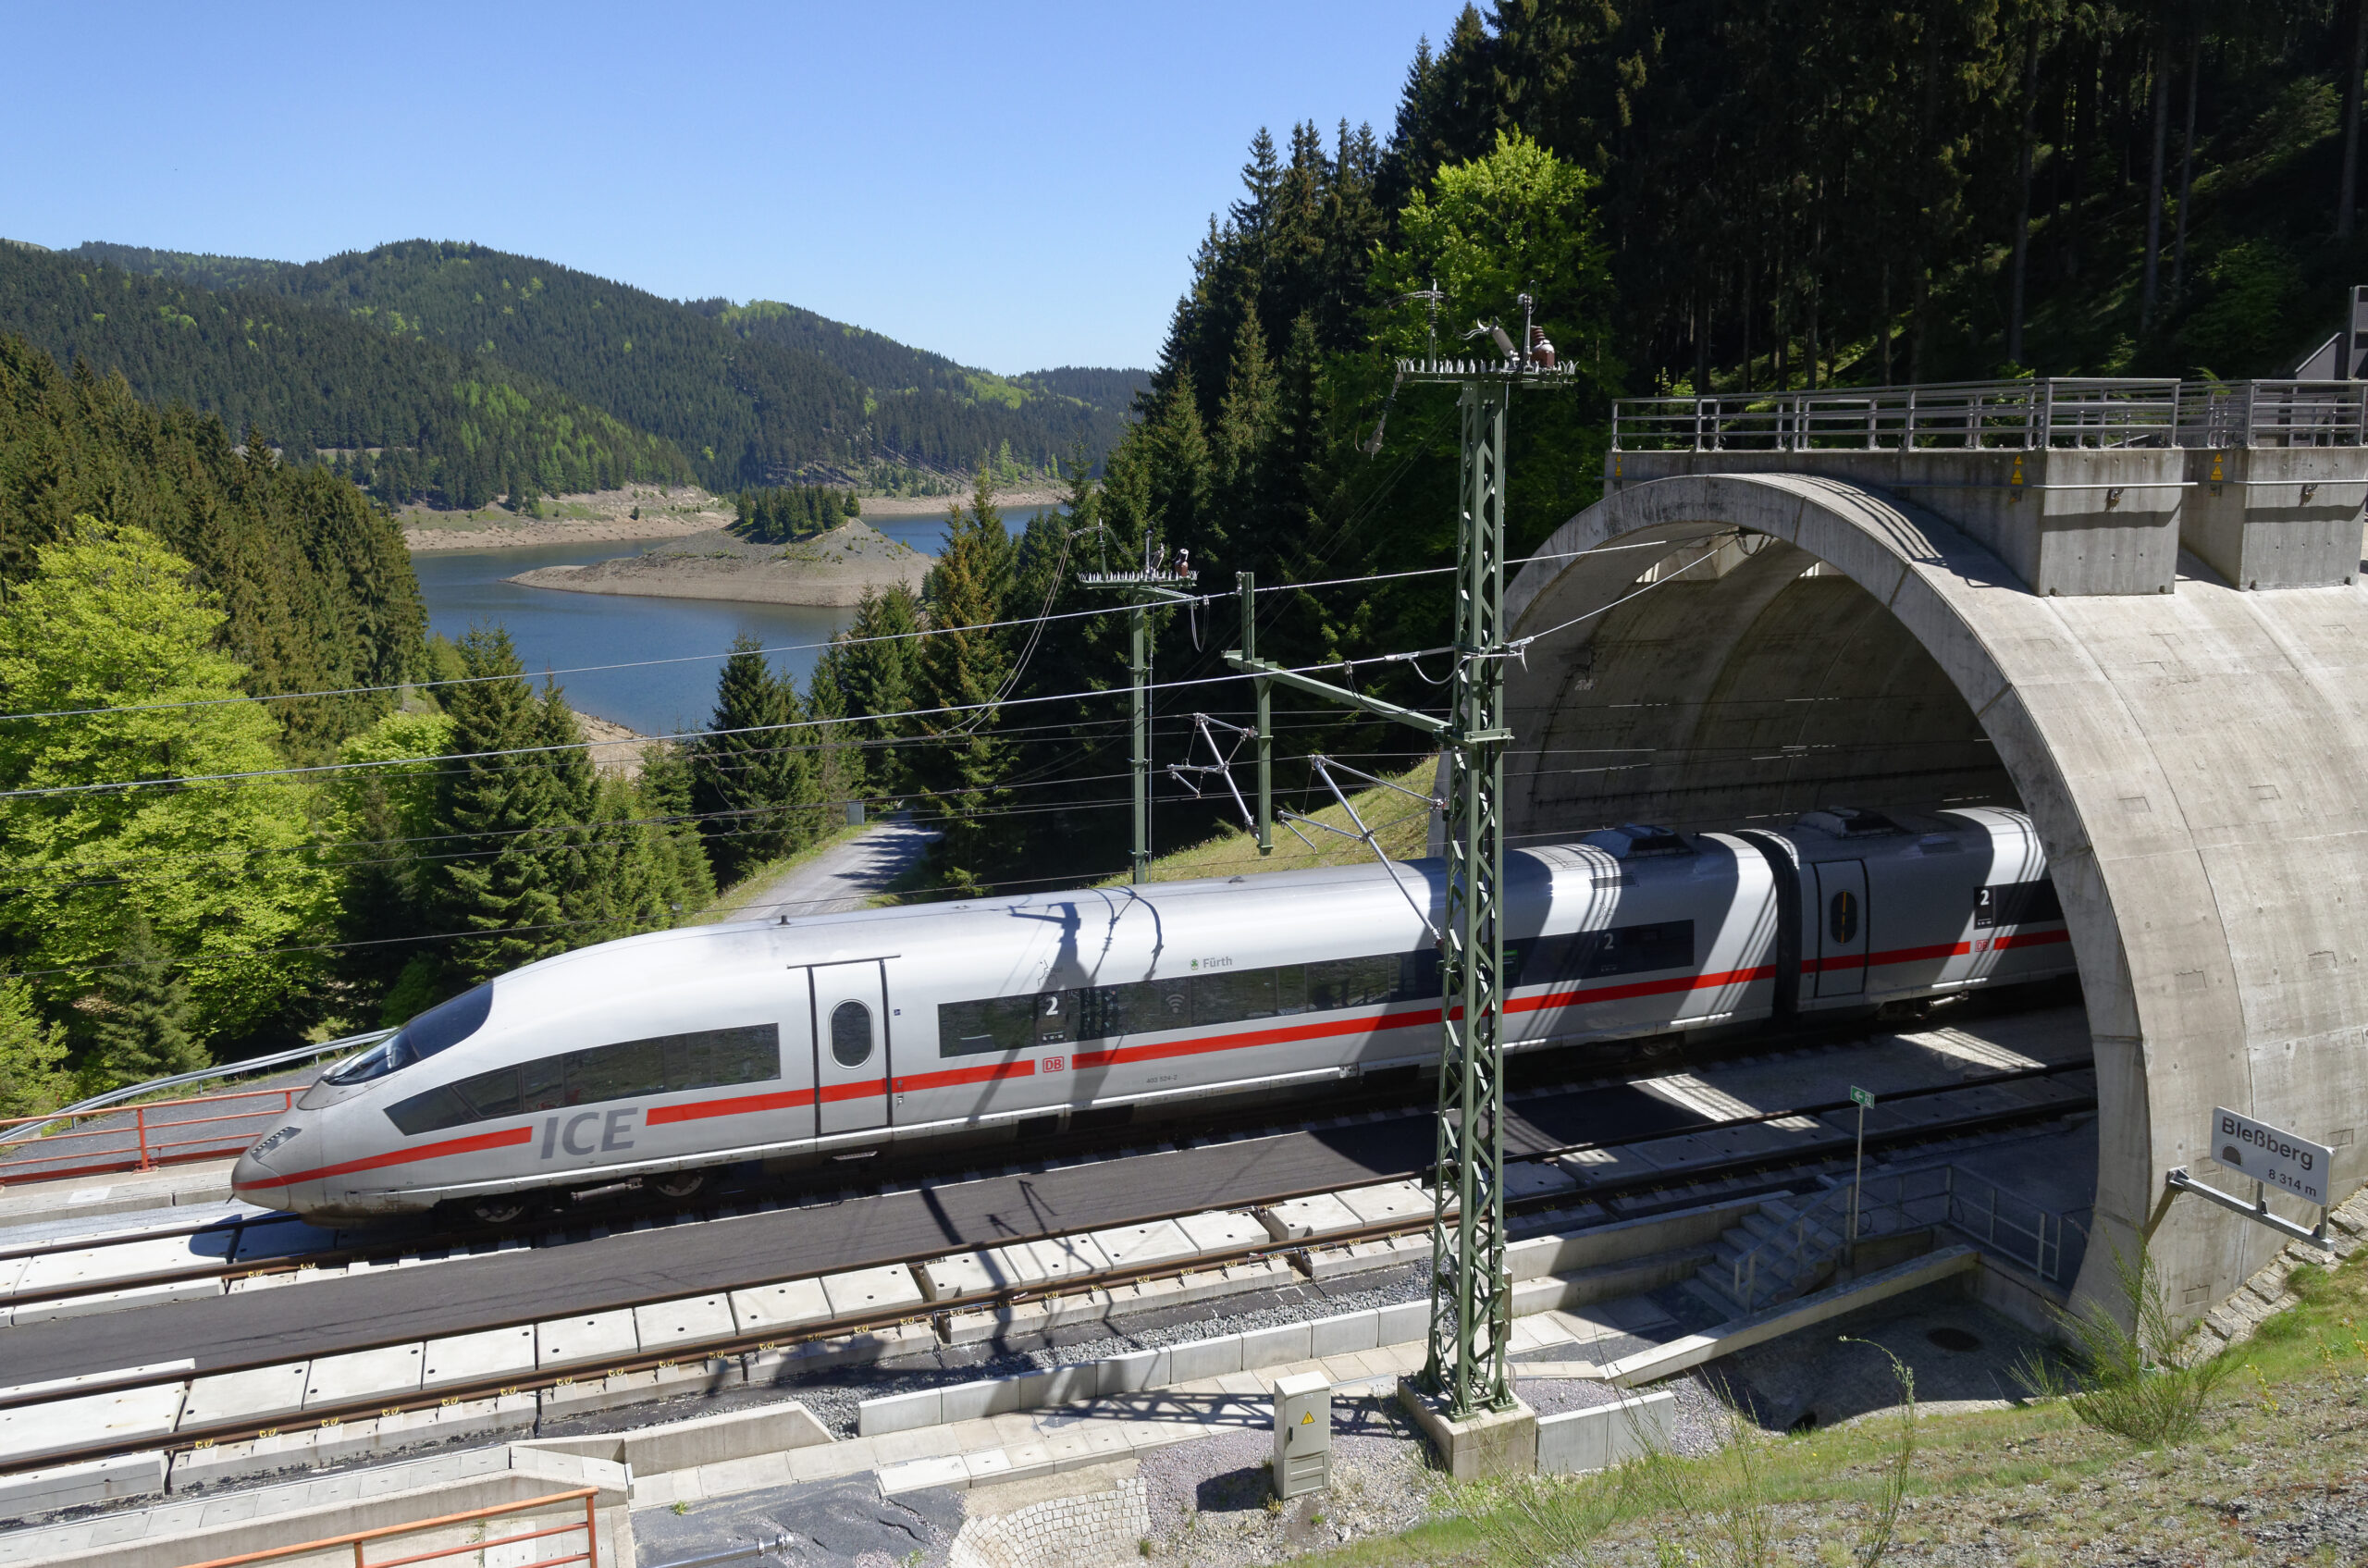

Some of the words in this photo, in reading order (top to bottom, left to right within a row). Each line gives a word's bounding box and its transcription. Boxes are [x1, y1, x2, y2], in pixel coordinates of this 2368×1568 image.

[1980, 890, 1990, 906] 2
[1604, 932, 1614, 950] 2
[1203, 956, 1232, 968] Fürth
[1045, 996, 1059, 1016] 2
[1044, 1057, 1063, 1073] DB
[541, 1107, 638, 1159] ICE
[2222, 1117, 2313, 1171] Bleßberg
[2305, 1184, 2317, 1197] m
